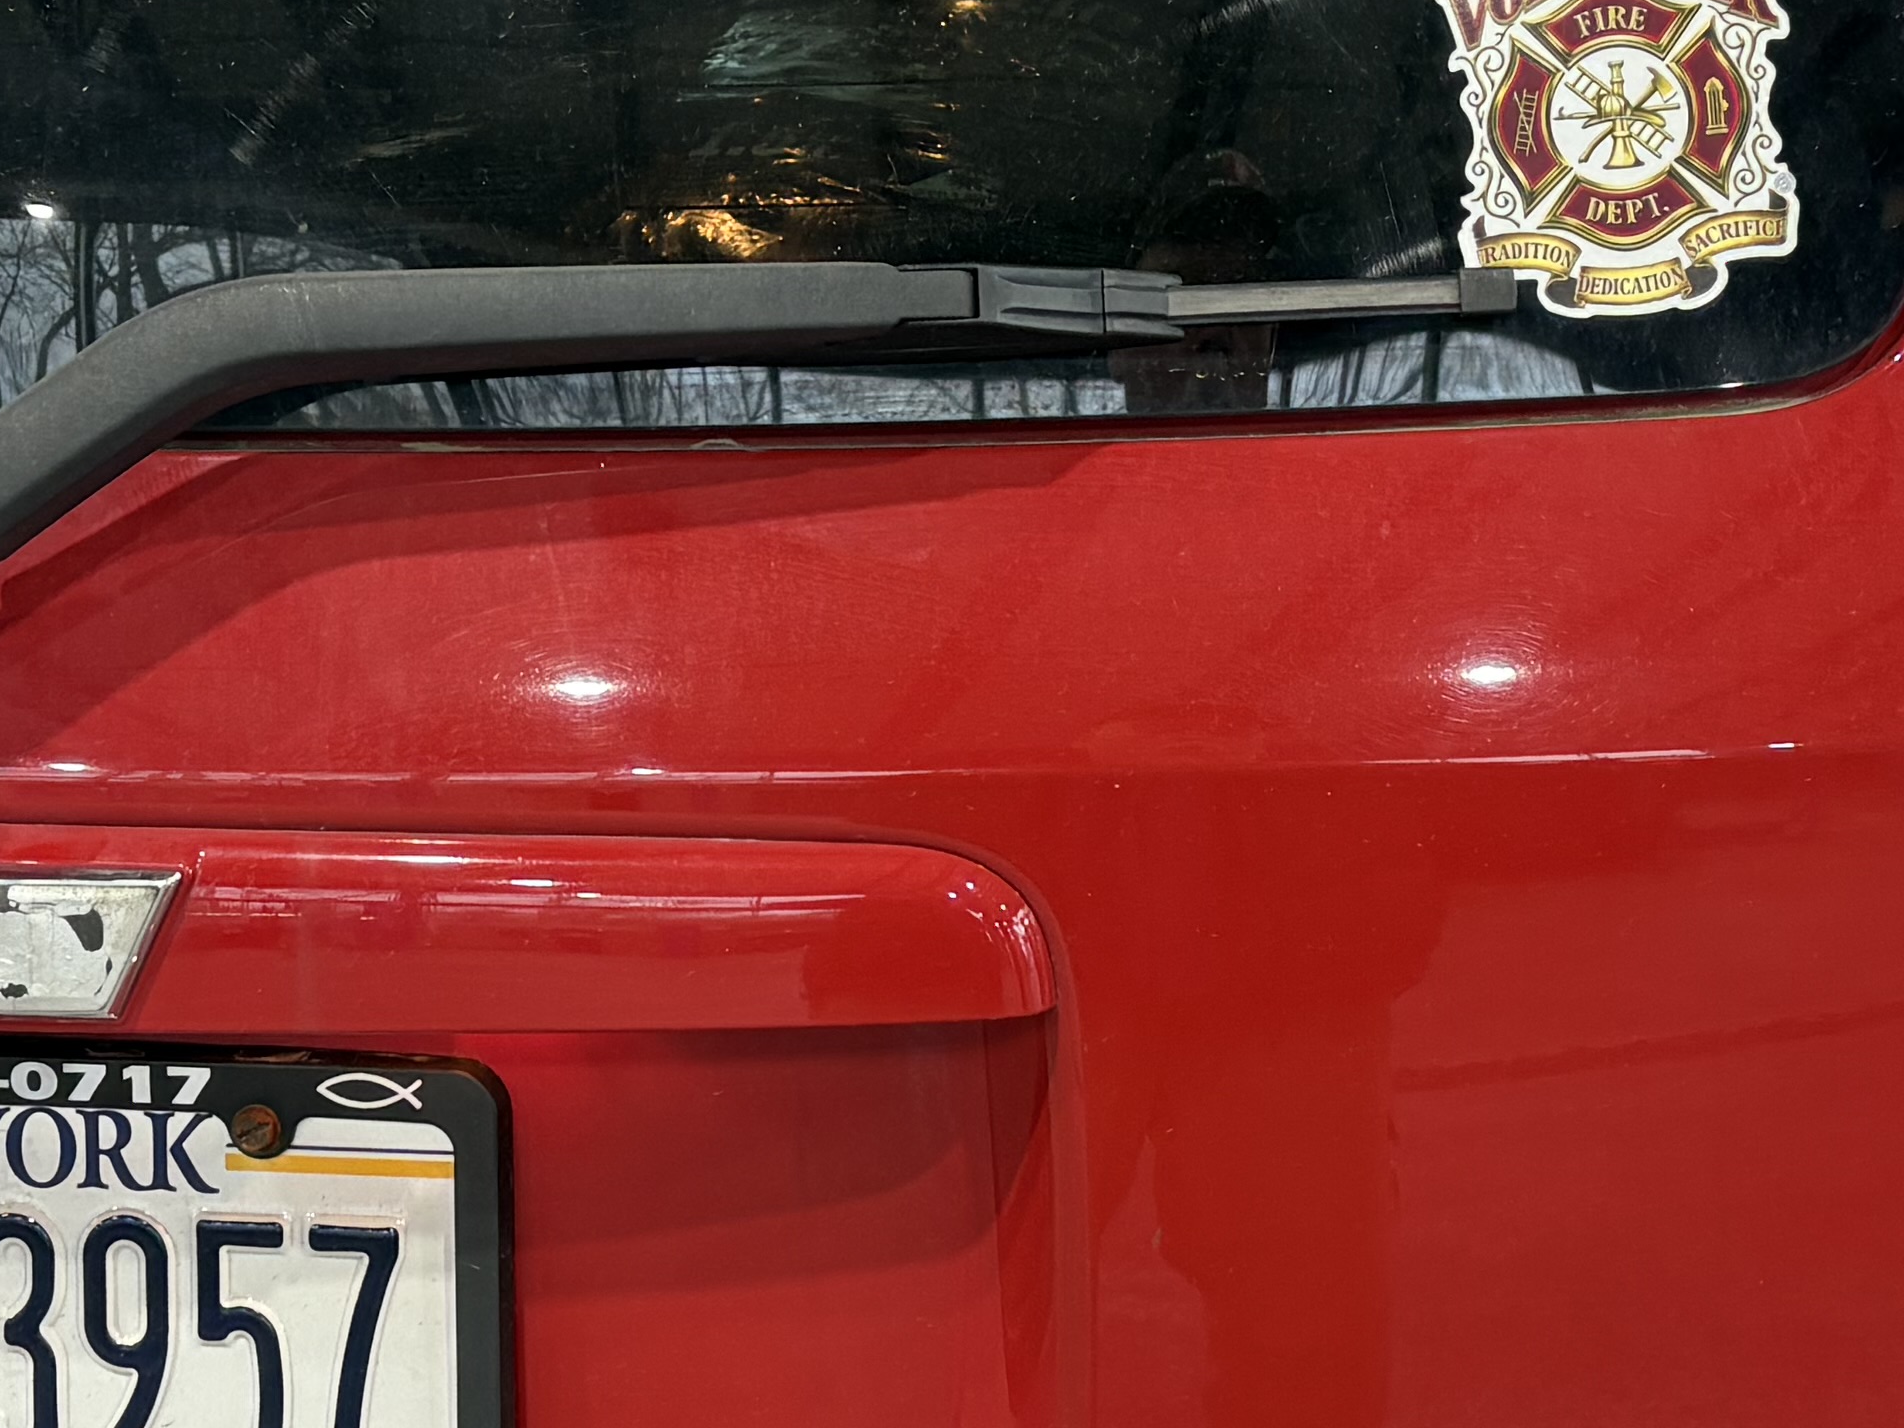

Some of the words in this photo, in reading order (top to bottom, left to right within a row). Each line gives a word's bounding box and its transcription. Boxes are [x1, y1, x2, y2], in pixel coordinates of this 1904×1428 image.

[1572, 4, 1648, 40] FIRE
[1584, 191, 1672, 227] DEPT.
[1578, 265, 1686, 296] DEDICATION
